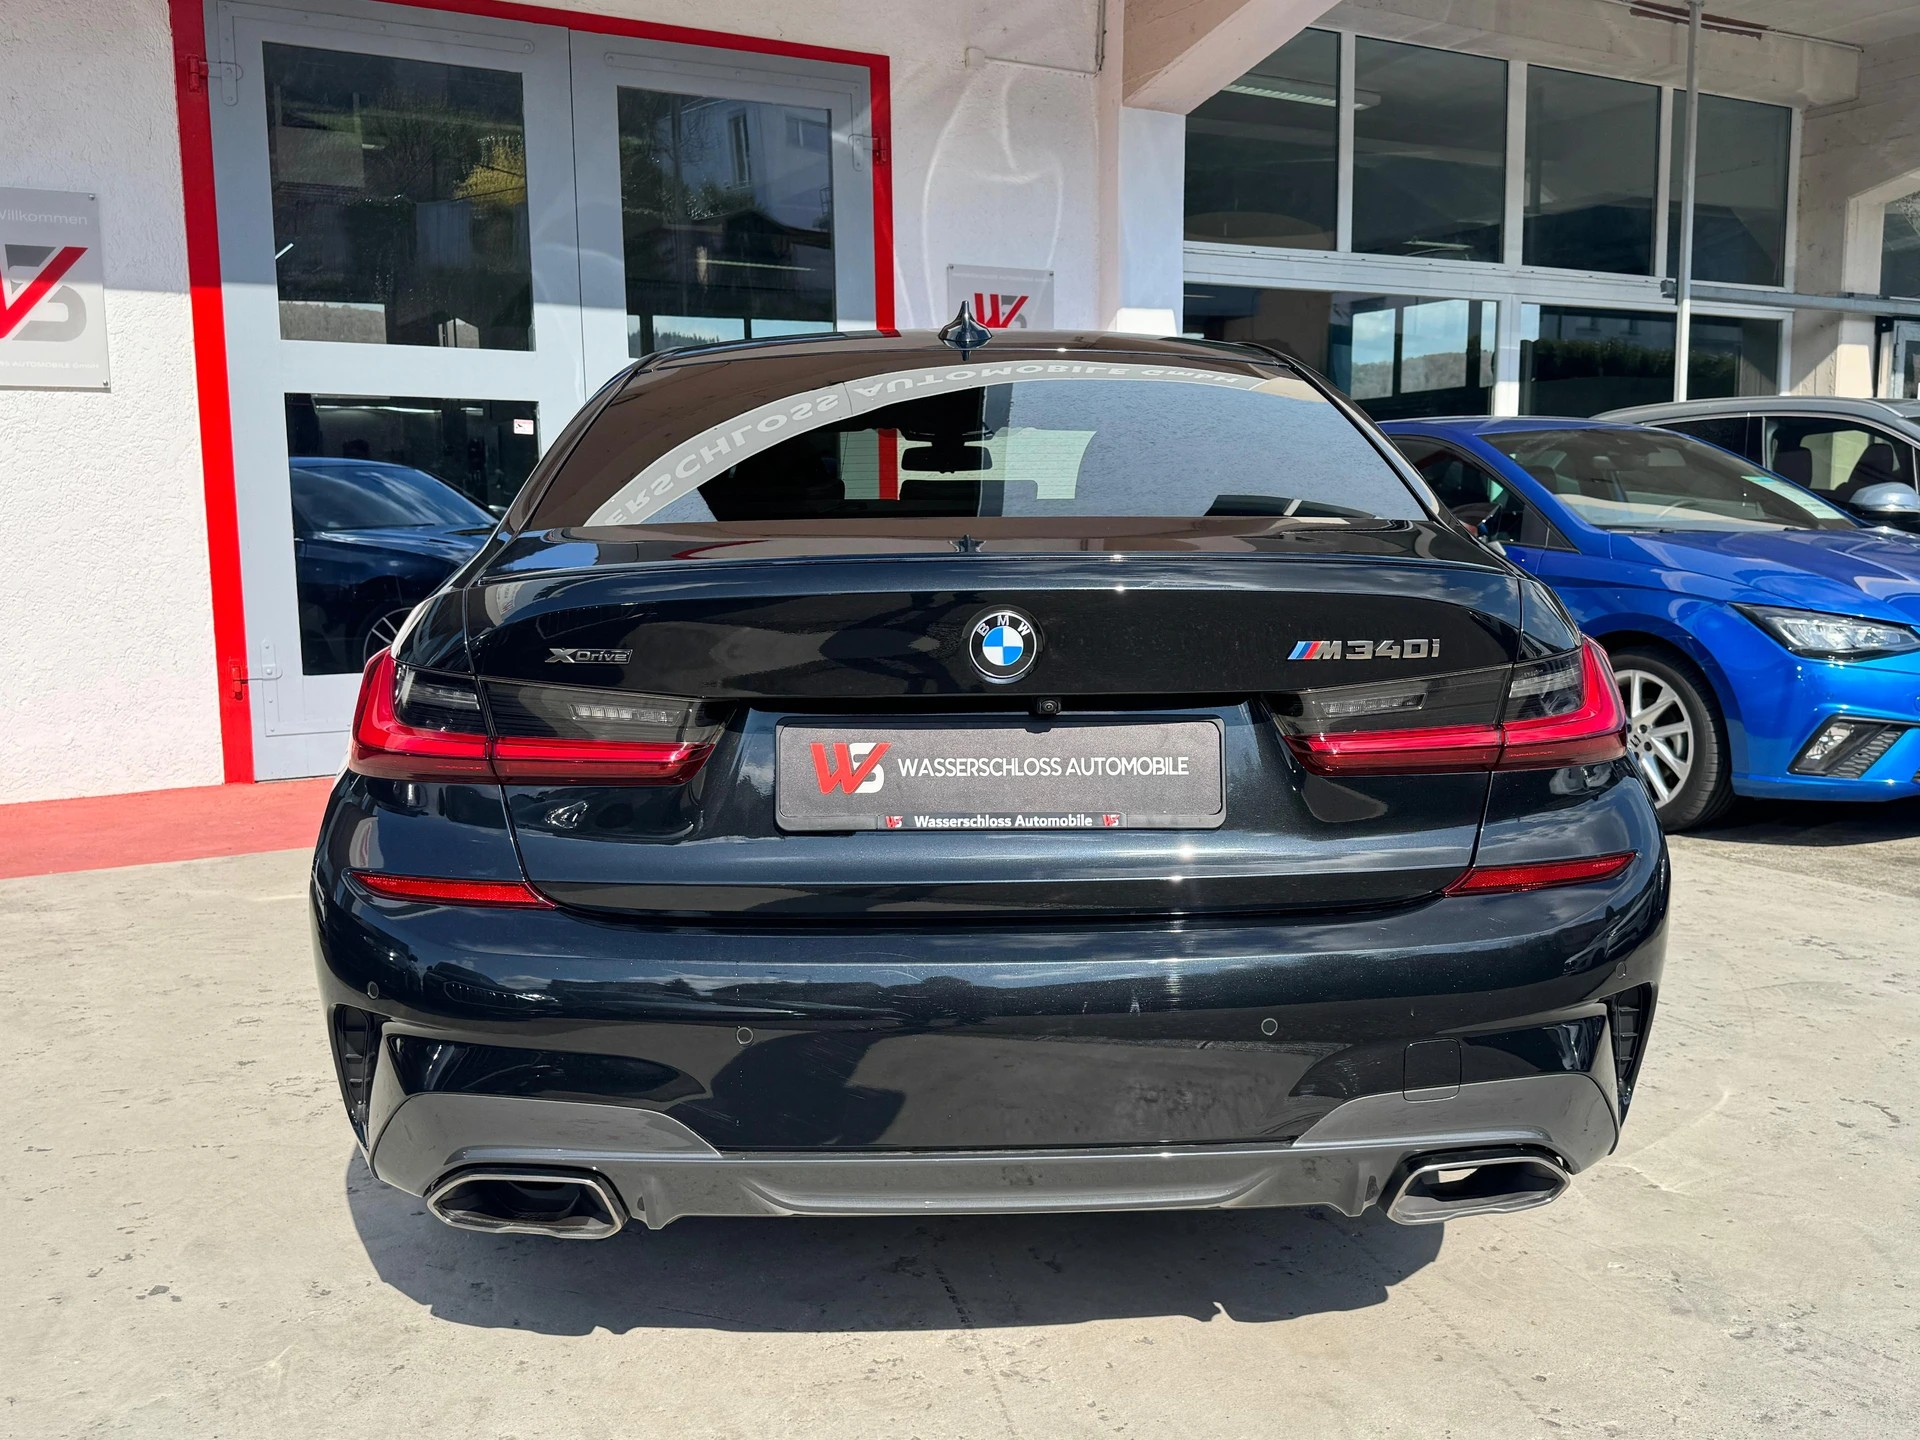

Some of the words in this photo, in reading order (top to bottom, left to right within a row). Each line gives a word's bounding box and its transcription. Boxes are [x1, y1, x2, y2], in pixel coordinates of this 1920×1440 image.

[976, 613, 1031, 637] BMW
[1311, 638, 1441, 660] M340i
[898, 757, 1063, 777] WASSERSCHLOSS
[1065, 756, 1190, 776] AUTOMOBILE
[914, 815, 1011, 828] Wasserschloss
[1014, 813, 1093, 827] Automobile
